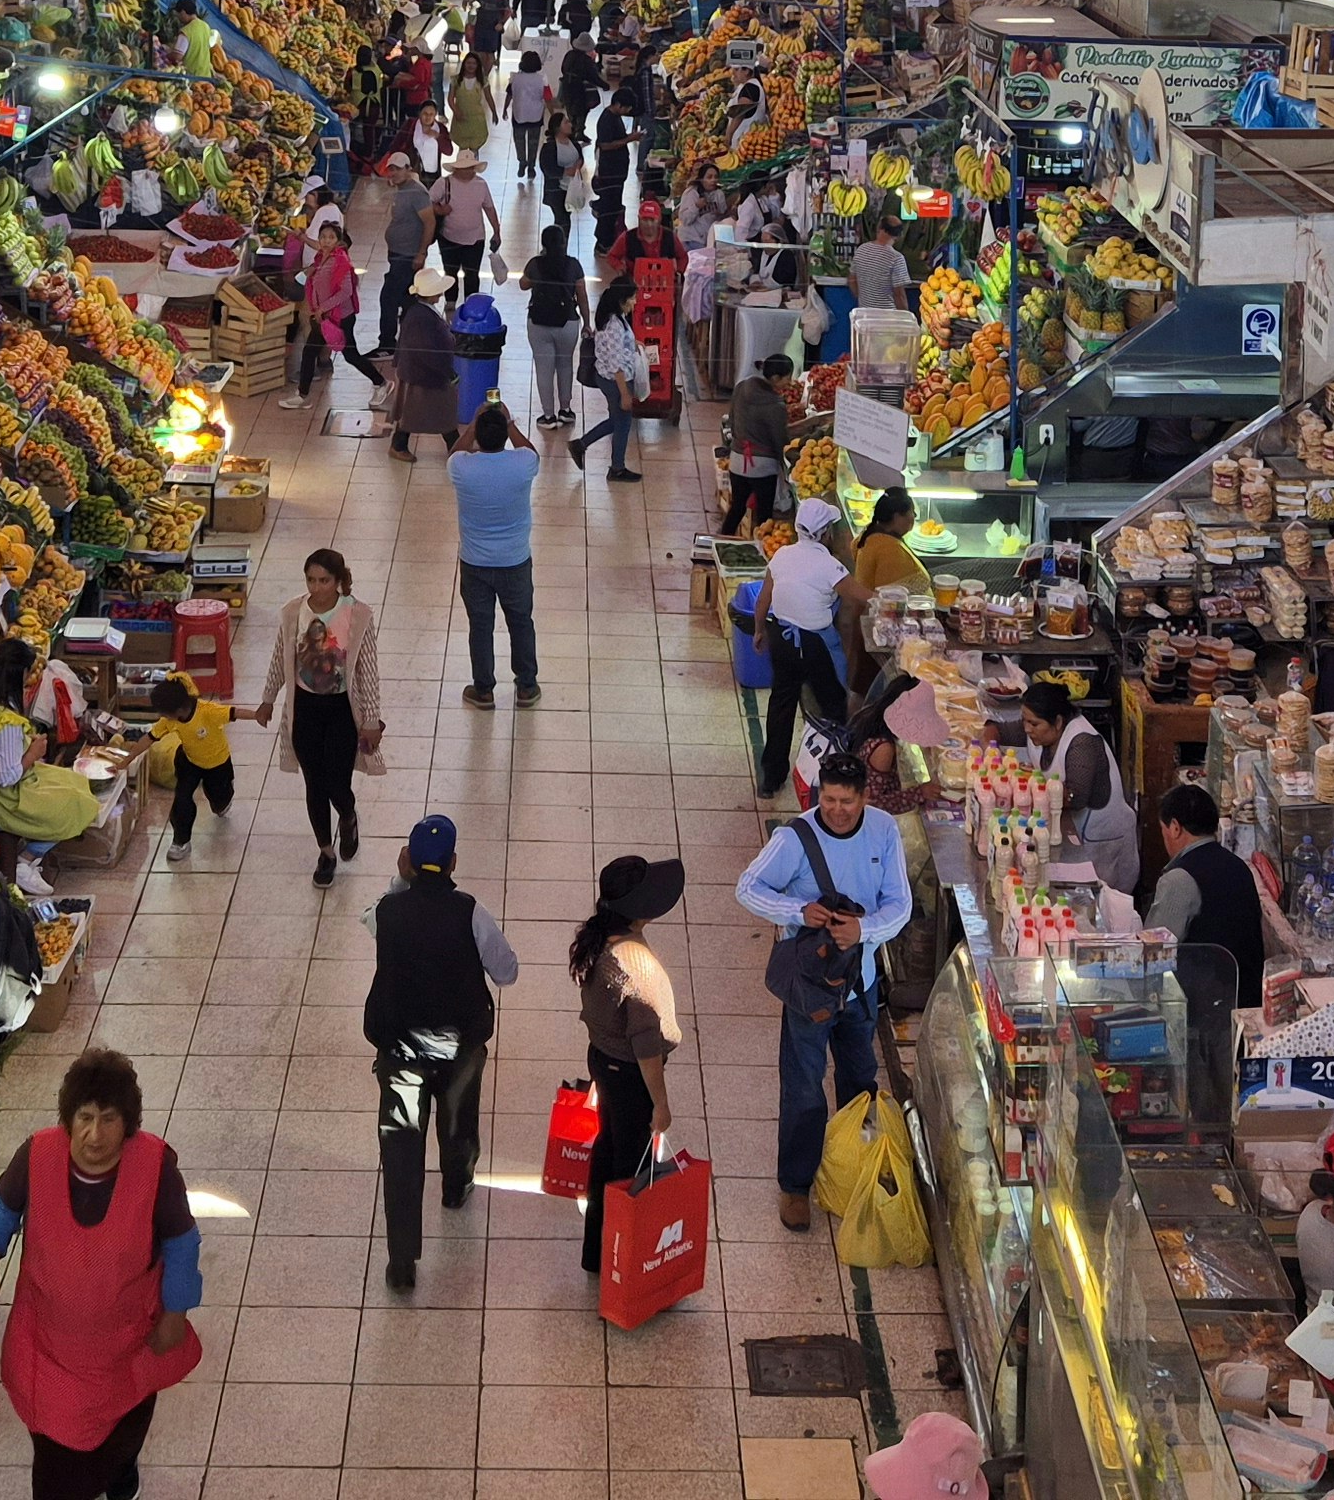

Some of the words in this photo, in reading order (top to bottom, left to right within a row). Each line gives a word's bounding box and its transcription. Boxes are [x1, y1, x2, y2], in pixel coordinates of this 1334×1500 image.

[1076, 47, 1154, 68] Productos
[1158, 49, 1223, 69] Luciana
[1164, 73, 1237, 90] derivados
[1176, 191, 1187, 214] 44
[561, 1145, 590, 1162] New
[642, 1257, 662, 1274] New
[663, 1240, 694, 1264] Athletic
